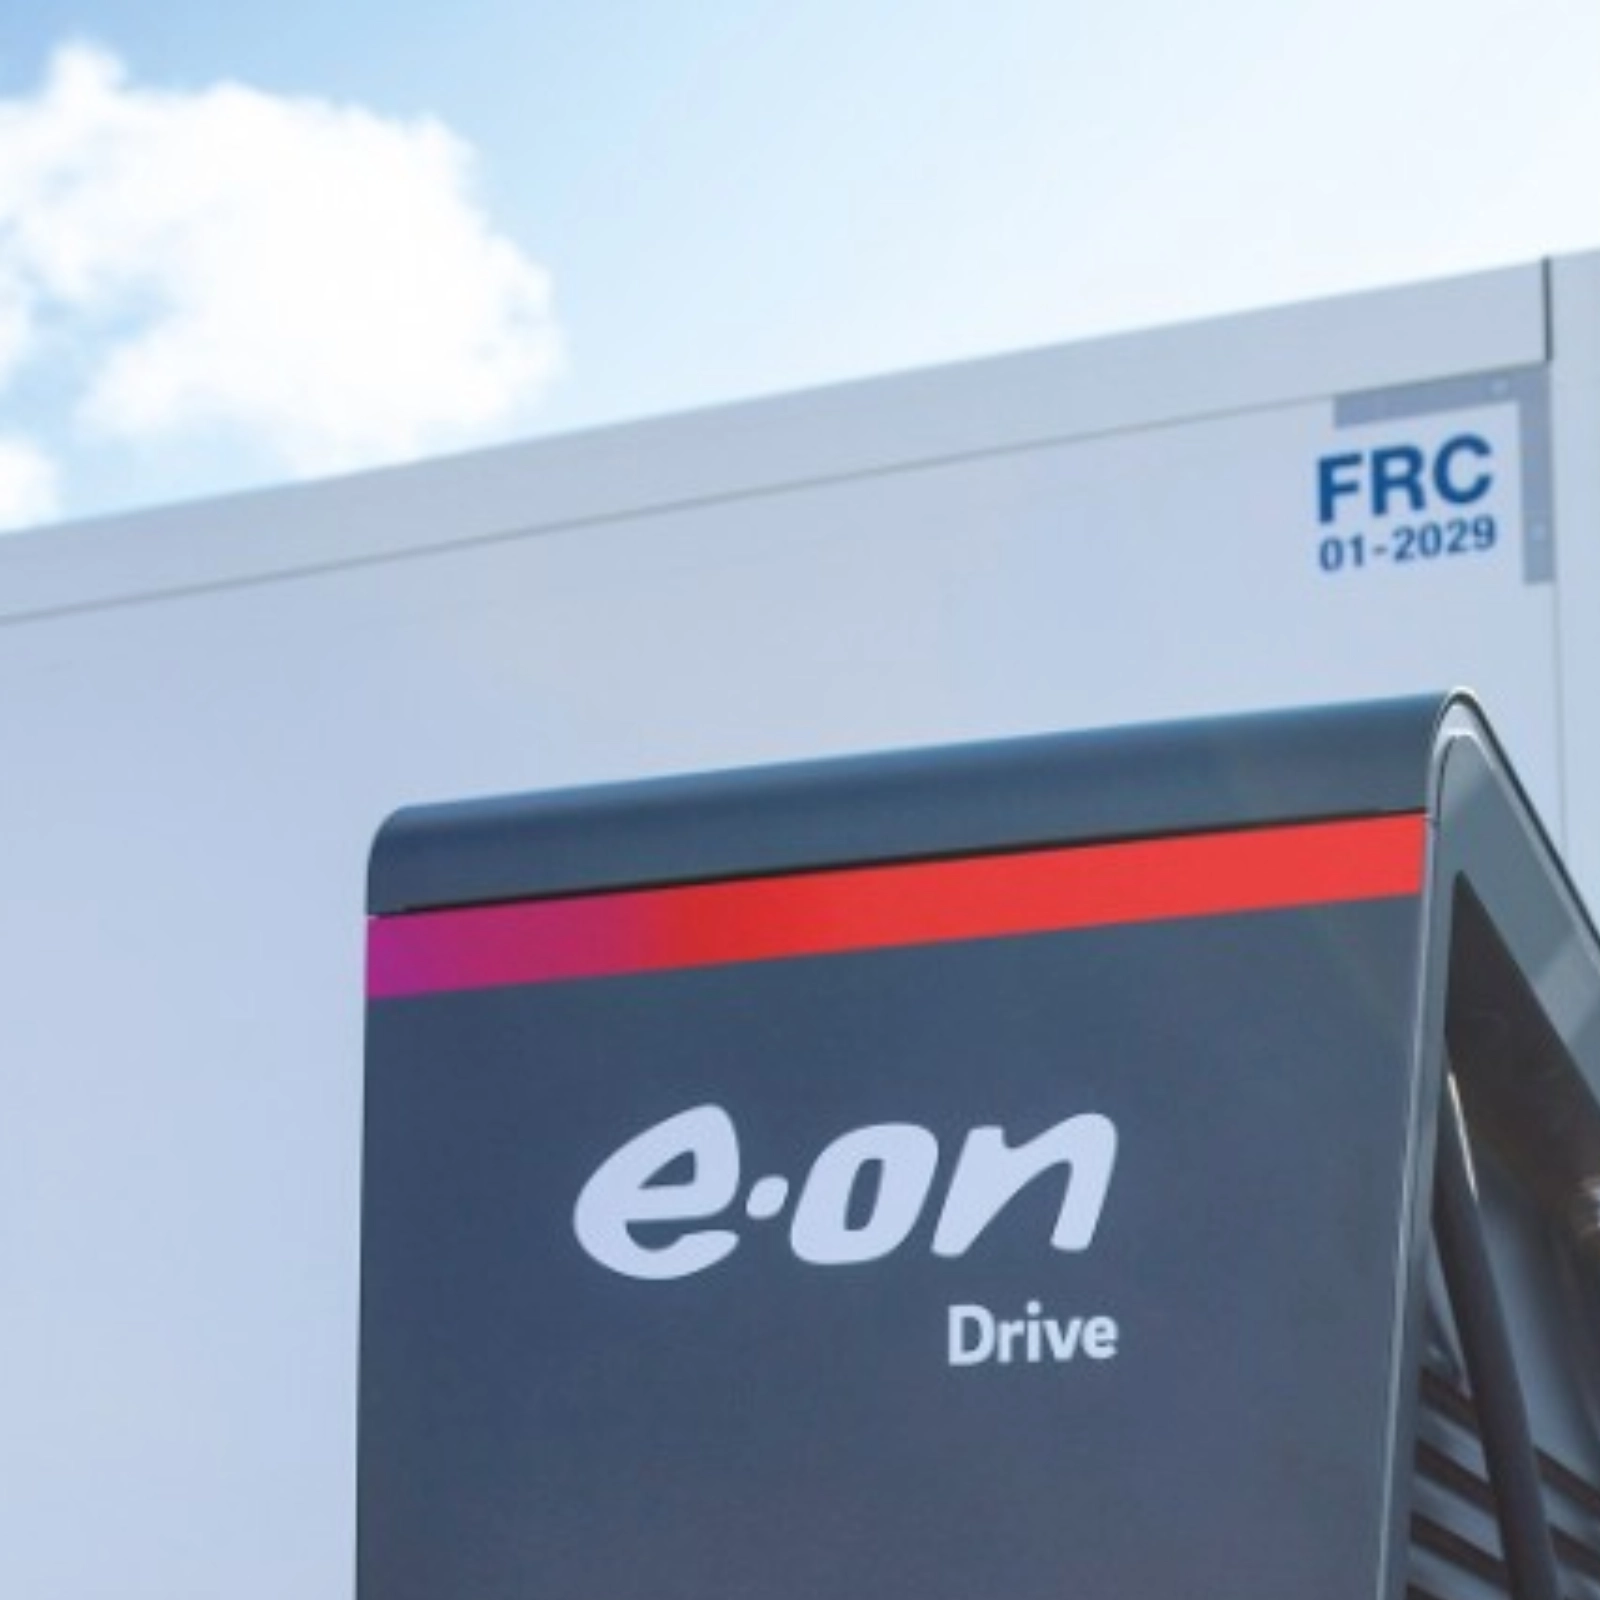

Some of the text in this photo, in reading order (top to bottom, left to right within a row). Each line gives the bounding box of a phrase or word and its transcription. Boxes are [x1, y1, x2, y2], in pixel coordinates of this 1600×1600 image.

[1317, 432, 1493, 524] FRC
[1319, 514, 1497, 572] 01-2029
[948, 1301, 1118, 1365] Drive
